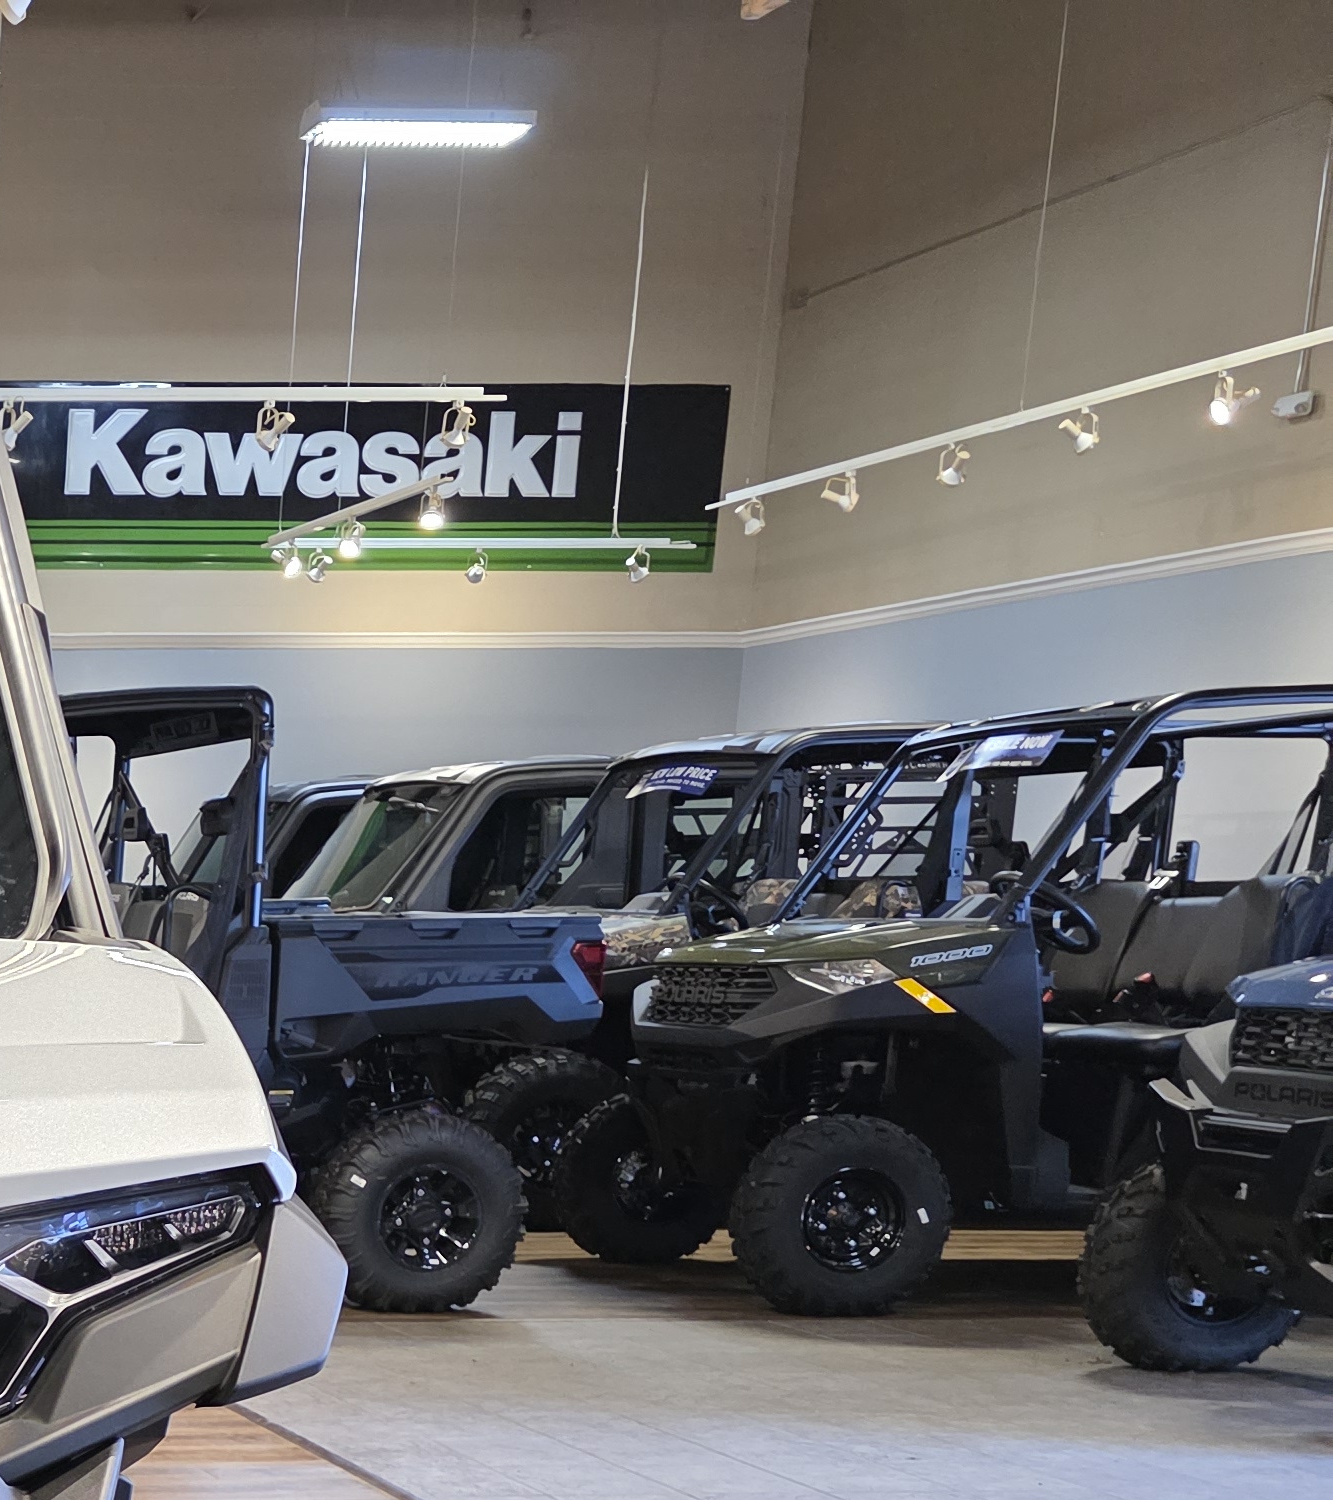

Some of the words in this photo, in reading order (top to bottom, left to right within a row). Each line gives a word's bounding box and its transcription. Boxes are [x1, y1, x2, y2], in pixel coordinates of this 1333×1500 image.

[63, 408, 583, 499] Kawasaki
[1020, 734, 1054, 750] NOW
[683, 766, 718, 781] PRICE
[910, 944, 993, 967] 1000
[373, 966, 540, 988] RANGER
[651, 983, 725, 1004] POLARIS
[1234, 1082, 1333, 1110] POLARIS
